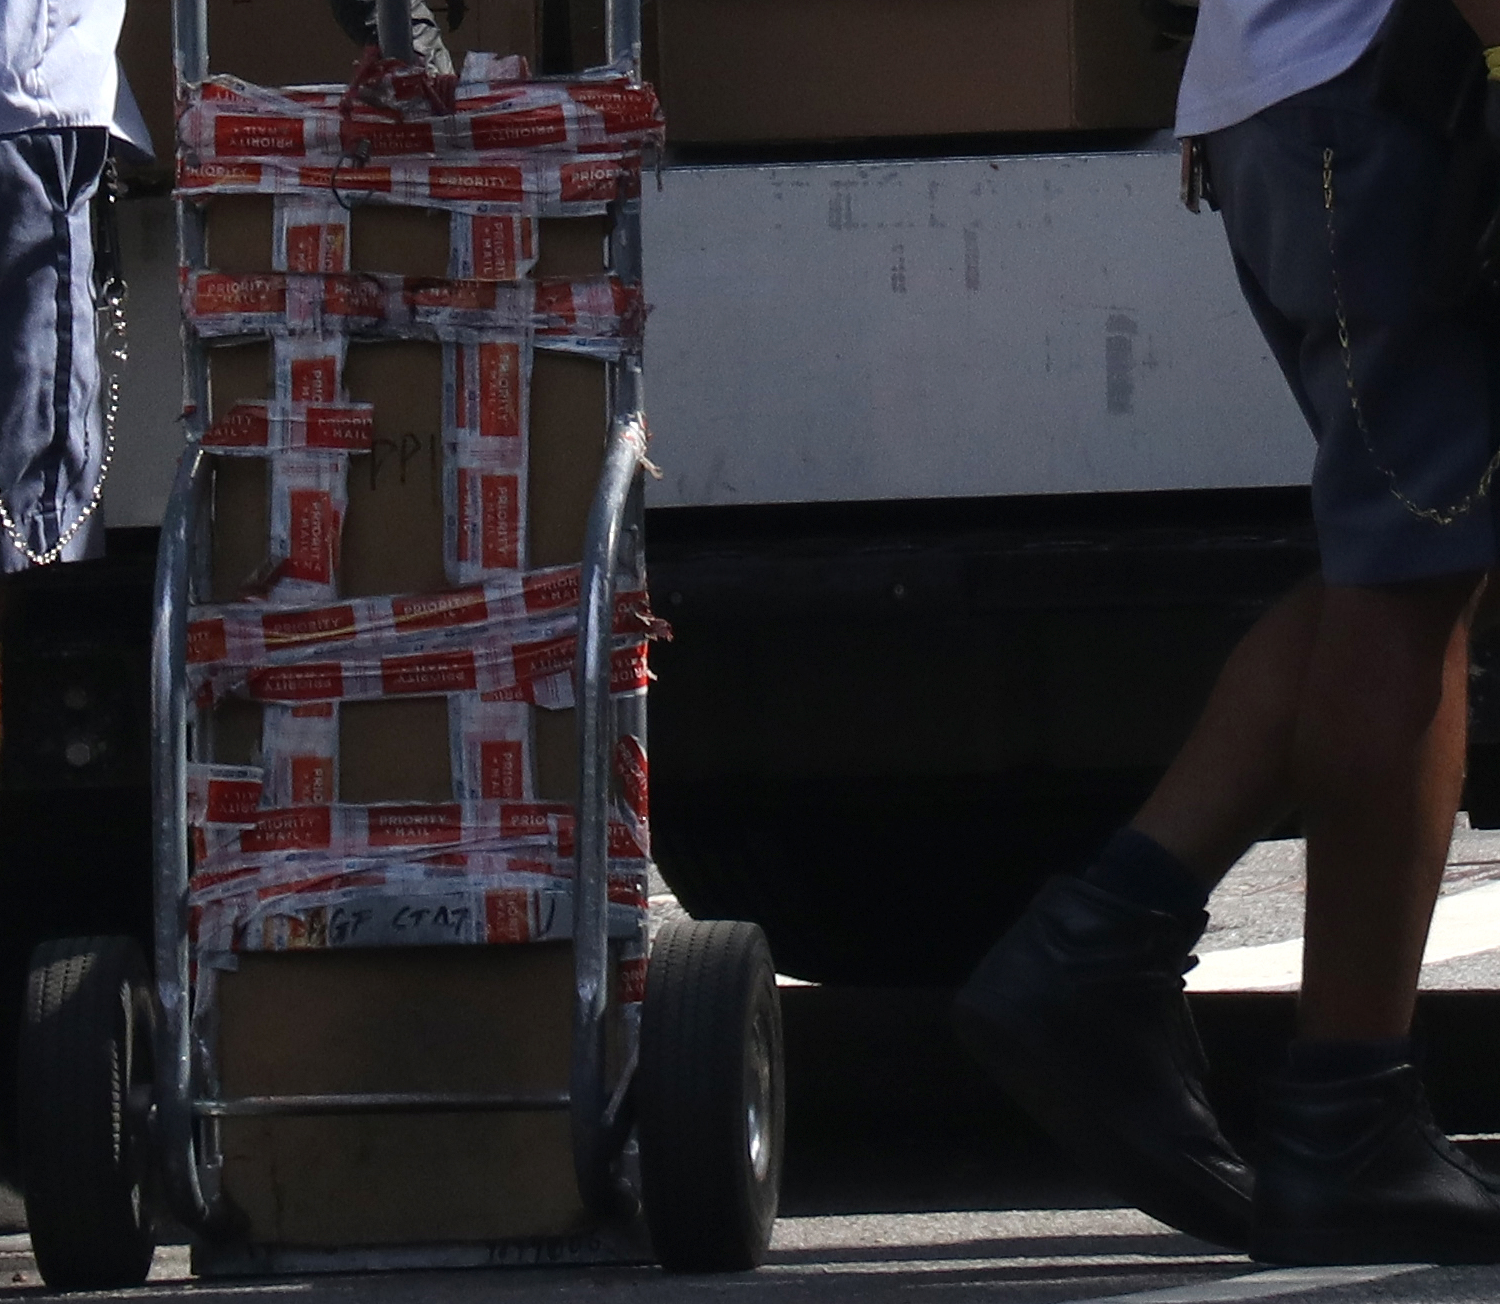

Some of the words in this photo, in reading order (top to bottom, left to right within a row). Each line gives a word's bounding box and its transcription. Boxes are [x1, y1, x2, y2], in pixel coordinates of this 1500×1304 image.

[229, 137, 294, 150] PRIORITY
[438, 175, 507, 187] PRIORITY
[207, 277, 272, 294] PRIORITY
[497, 354, 510, 429] PRIORITY
[332, 430, 368, 440] MAIL
[497, 486, 509, 555] PRIORITY
[273, 616, 340, 633] PRIORITY
[264, 678, 333, 692] PRIORITY
[399, 672, 465, 684] PRIORITY
[379, 813, 447, 827] PRIORITY
[511, 813, 548, 827] PRIO
[264, 830, 301, 841] MAIL
[395, 826, 431, 837] MAIL
